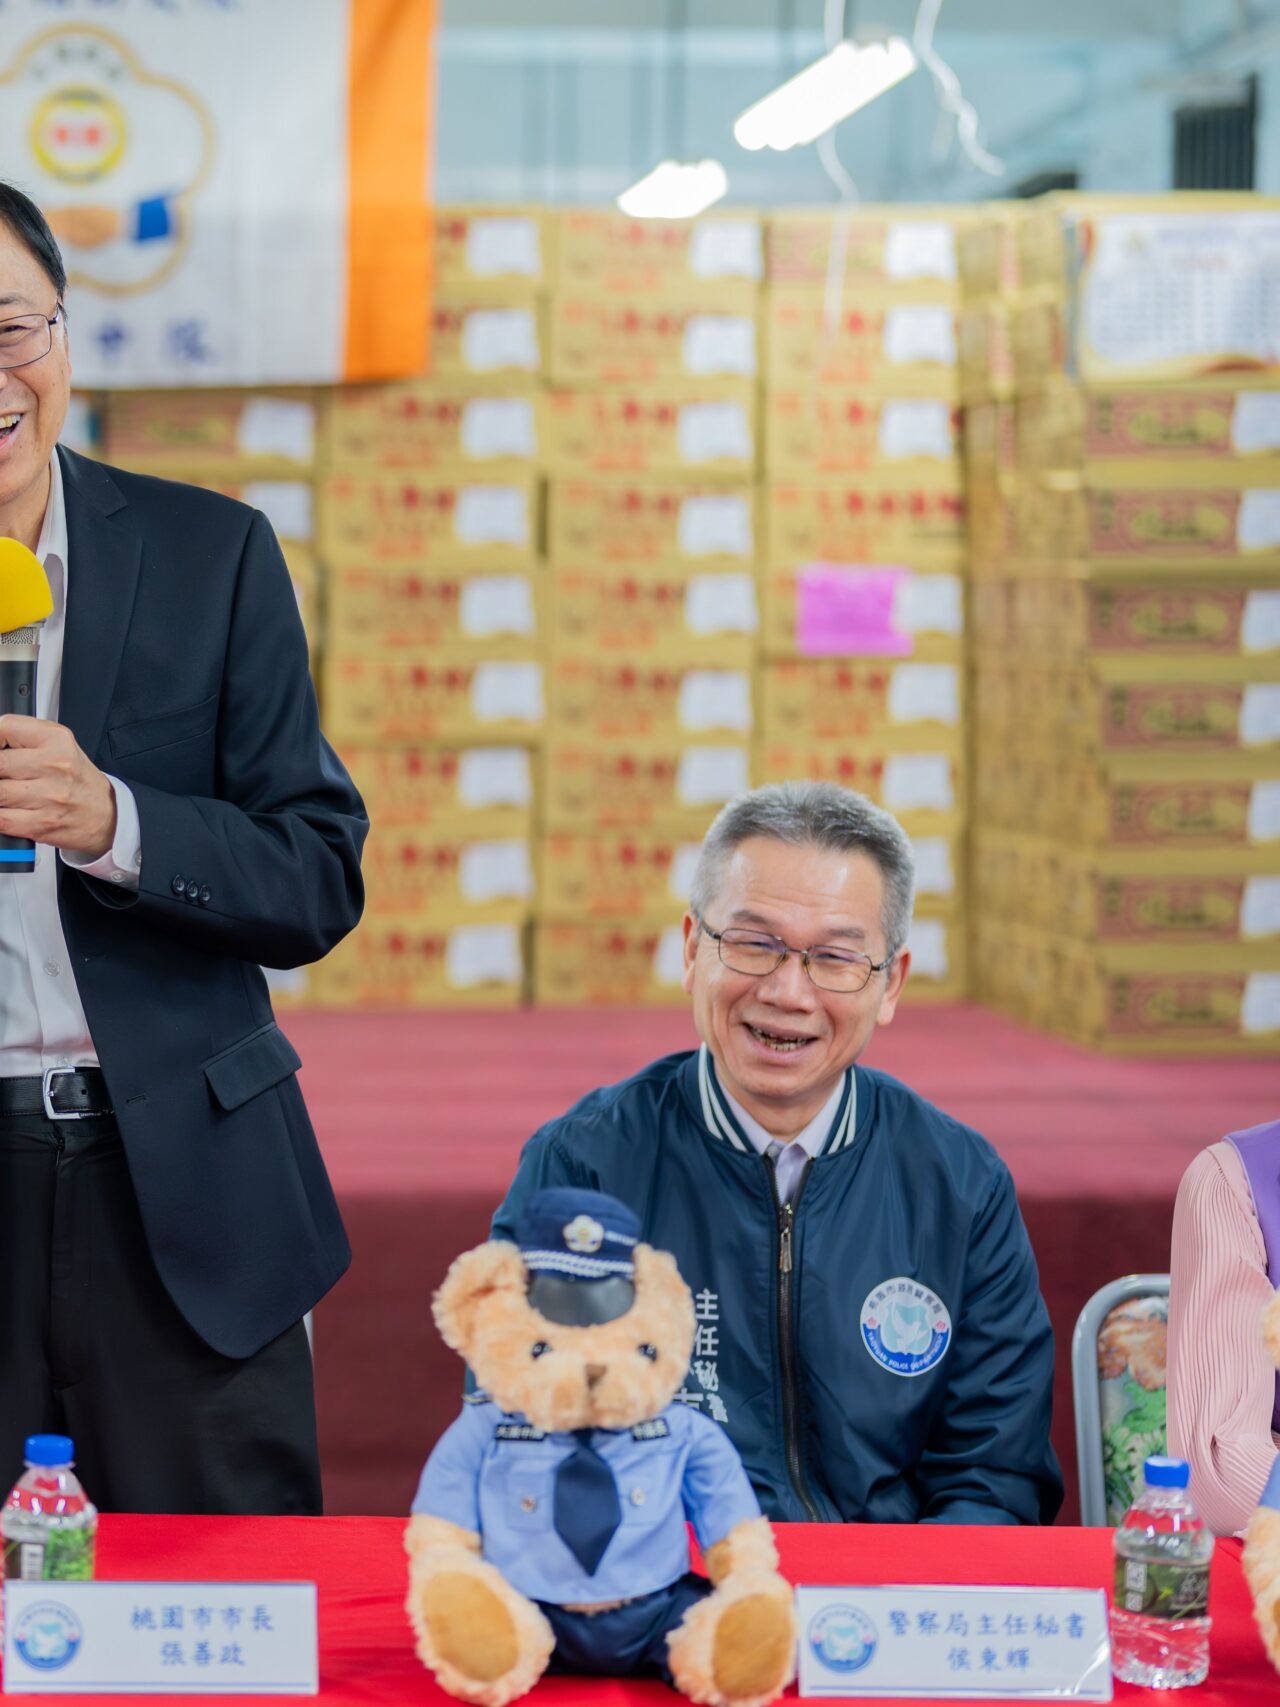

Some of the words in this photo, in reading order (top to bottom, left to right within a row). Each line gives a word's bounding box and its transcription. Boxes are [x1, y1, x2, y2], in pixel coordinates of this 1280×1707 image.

[130, 1605, 274, 1632] 桃園市市長
[889, 1610, 1086, 1639] 警察局主任秘書
[161, 1641, 245, 1666] 張善政
